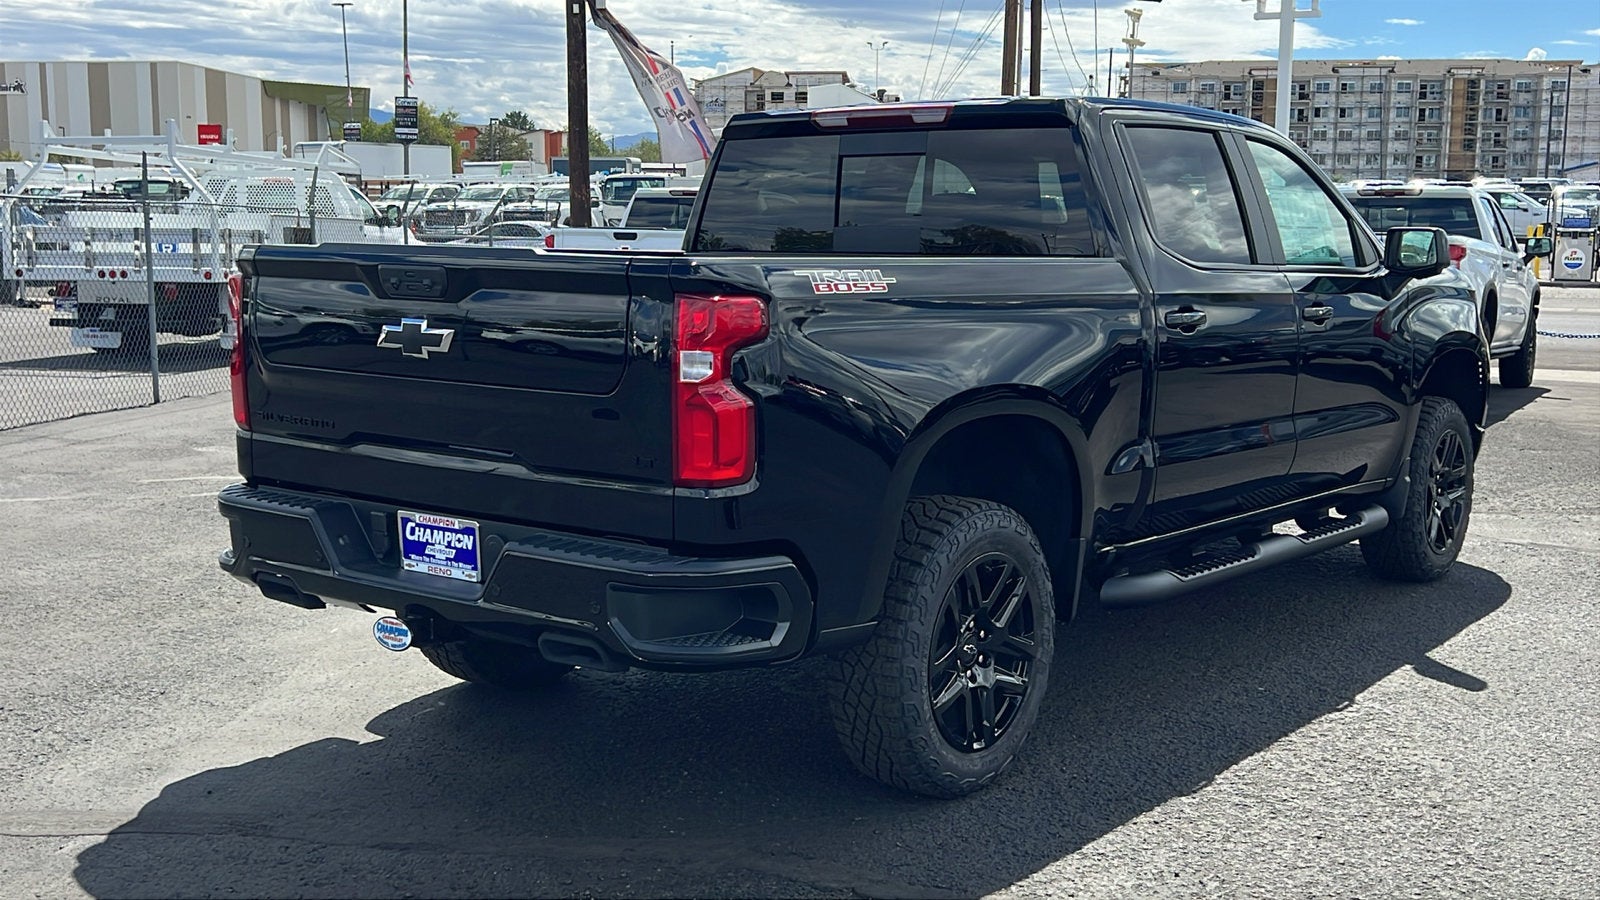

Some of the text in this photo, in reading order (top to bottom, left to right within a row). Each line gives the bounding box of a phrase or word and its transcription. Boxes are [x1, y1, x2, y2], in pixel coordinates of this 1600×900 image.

[396, 98, 417, 106] Corwin
[793, 269, 896, 283] TRAIL
[813, 282, 888, 294] BOSS
[419, 515, 455, 527] CHAMPION
[406, 522, 473, 550] CHAMPION
[427, 547, 454, 556] CHEVROLET
[428, 566, 452, 576] RENO
